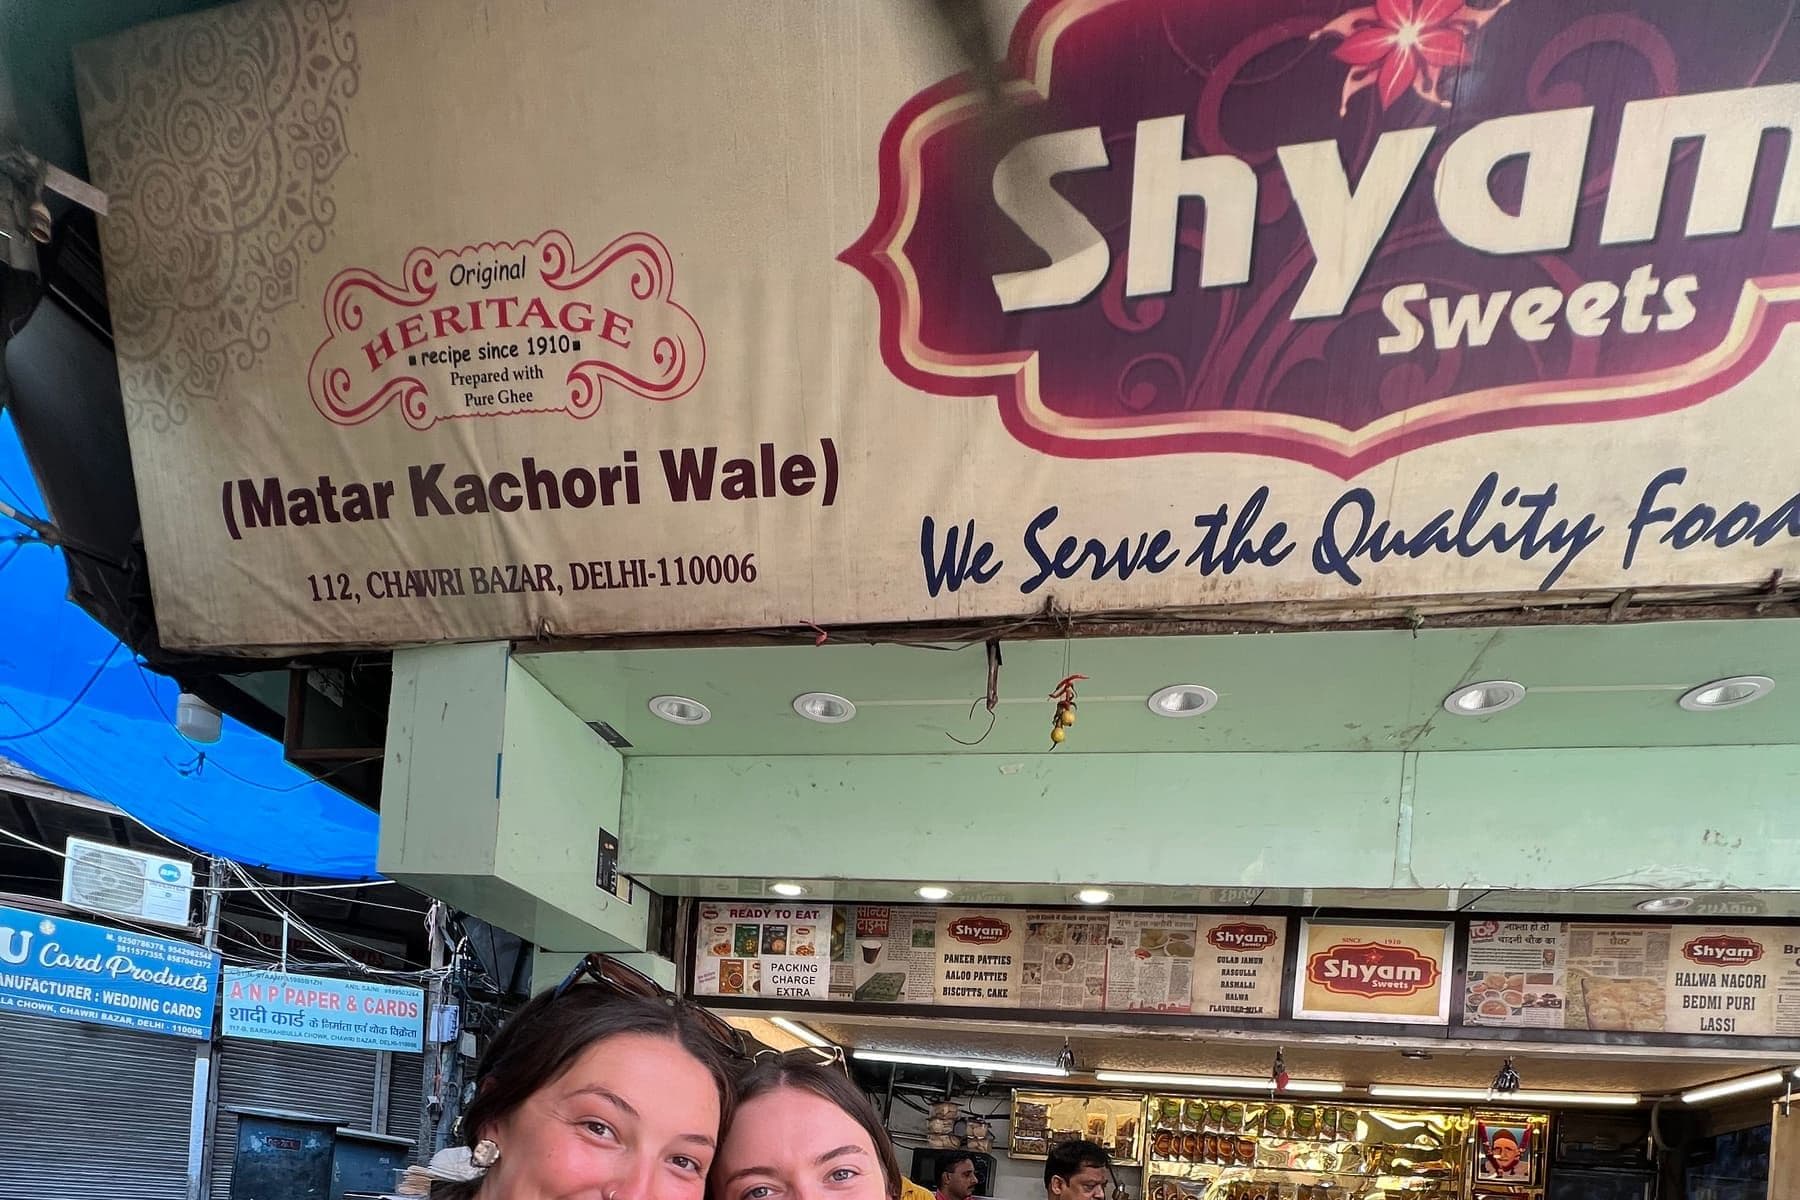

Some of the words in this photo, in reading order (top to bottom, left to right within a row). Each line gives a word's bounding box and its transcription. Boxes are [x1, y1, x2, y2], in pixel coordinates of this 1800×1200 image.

[991, 83, 1800, 320] Shyam
[450, 256, 526, 289] Original
[1378, 265, 1700, 356] Sweets
[361, 296, 634, 372] HERITAGE
[421, 346, 471, 368] recipe
[479, 341, 519, 361] since
[527, 335, 570, 356] 1910
[450, 367, 509, 389] Prepared
[514, 364, 544, 381] with
[464, 392, 494, 407] Pure
[498, 389, 534, 404] Ghee
[222, 475, 395, 540] (Matar
[407, 450, 641, 517] Kachori
[659, 438, 839, 506] Wale)
[921, 516, 1004, 598] We
[1021, 506, 1180, 593] Serve
[1187, 485, 1296, 577] the
[1312, 472, 1604, 591] Quality
[307, 572, 361, 604] 112,
[366, 568, 465, 599] CHAWRI
[470, 563, 563, 597] BAZAR,
[569, 553, 757, 591] DELHI-110006
[729, 909, 771, 919] READY
[773, 909, 791, 919] TO
[796, 910, 820, 920] EAT
[955, 924, 1003, 937] Shyam
[1216, 931, 1268, 944] Shyam
[944, 953, 975, 964] PANEER
[977, 954, 1011, 965] PATTIES
[1693, 945, 1754, 959] Shyam
[39, 942, 102, 973] Card
[105, 955, 208, 992] Products
[771, 963, 818, 973] PACKING
[945, 971, 972, 981] AALOO
[974, 971, 1008, 982] PATTIES
[1323, 959, 1421, 983] Shyam
[772, 975, 816, 985] CHARGE
[1372, 980, 1408, 989] Sweets
[1675, 972, 1717, 988] HALWA
[1720, 973, 1767, 989] NAGORI
[230, 981, 243, 1000] A
[249, 984, 261, 1001] N
[268, 986, 279, 1003] P
[285, 987, 340, 1009] PAPER
[346, 994, 357, 1011] &
[364, 997, 418, 1018] CARDS
[776, 987, 811, 997] EXTRA
[987, 988, 1008, 998] CAKE
[102, 989, 159, 1012] WEDDING
[162, 1001, 202, 1019] CARDS
[1682, 995, 1722, 1010] BEDMI
[1726, 996, 1756, 1011] PURI
[16, 999, 57, 1013] CHOWK,
[59, 1006, 98, 1019] CHAWRI
[100, 1012, 135, 1026] BAZAR,
[137, 1017, 164, 1029] DELHI
[229, 1004, 267, 1023] शादी
[271, 1009, 305, 1028] कार्ड
[309, 1018, 320, 1028] के
[1700, 1016, 1736, 1032] LASSI
